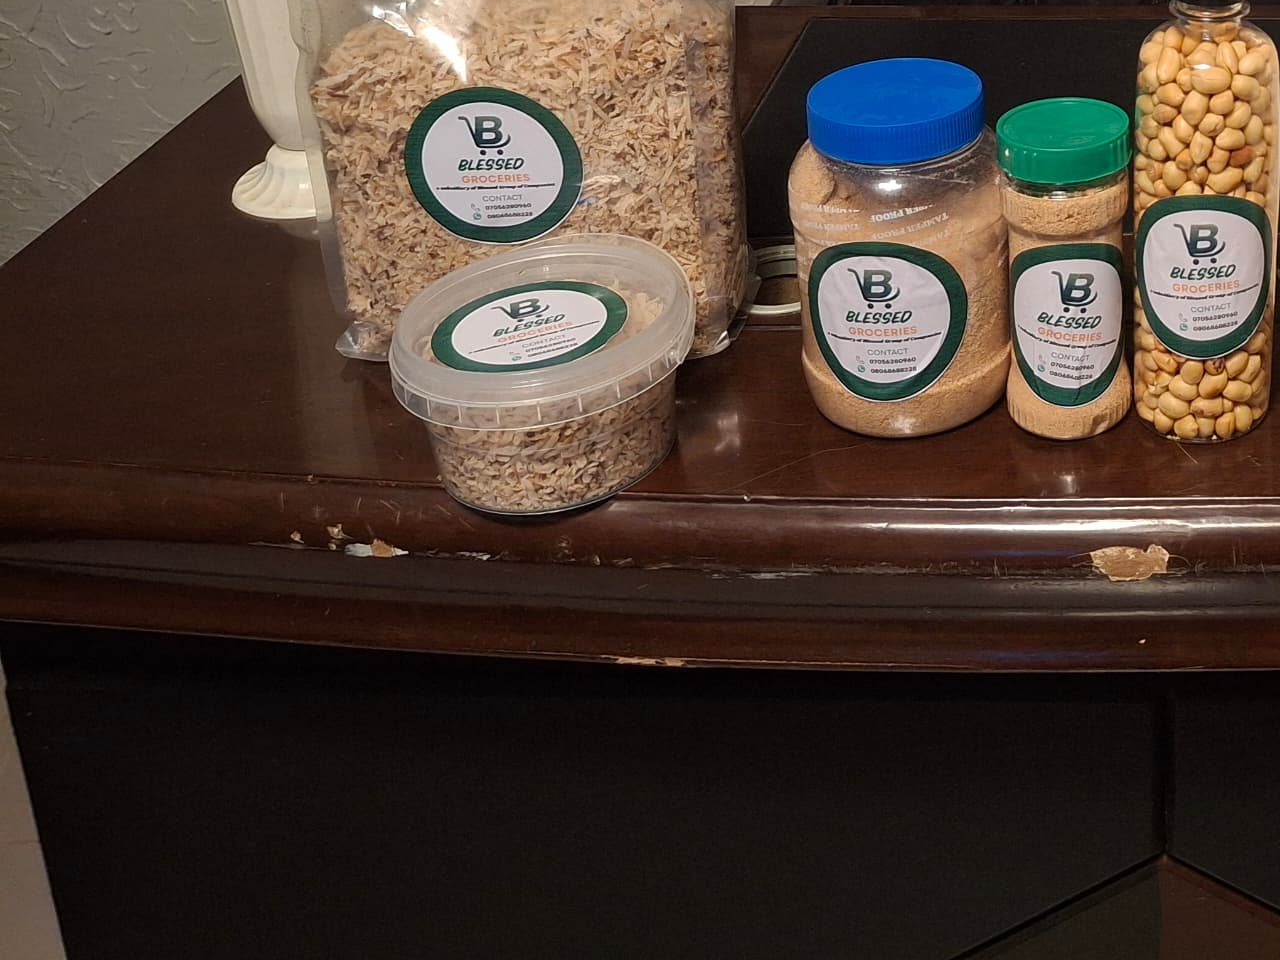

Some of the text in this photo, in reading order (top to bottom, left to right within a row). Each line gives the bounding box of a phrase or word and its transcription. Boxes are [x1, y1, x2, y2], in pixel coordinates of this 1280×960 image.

[458, 158, 524, 171] BLESSED
[462, 174, 530, 183] GROCERIES
[482, 194, 522, 202] CONTACT
[1170, 264, 1236, 280] BLESSED
[1172, 279, 1240, 294] GROCERIES
[1190, 303, 1231, 313] CONTACT
[846, 310, 912, 324] BLESSED
[1037, 312, 1102, 329] BLESSED
[493, 313, 566, 337] BLESSED
[849, 326, 918, 337] GROCERIES
[1038, 327, 1103, 342] GROCERIES
[867, 348, 908, 356] CONTACT
[1051, 351, 1090, 362] CONTACT
